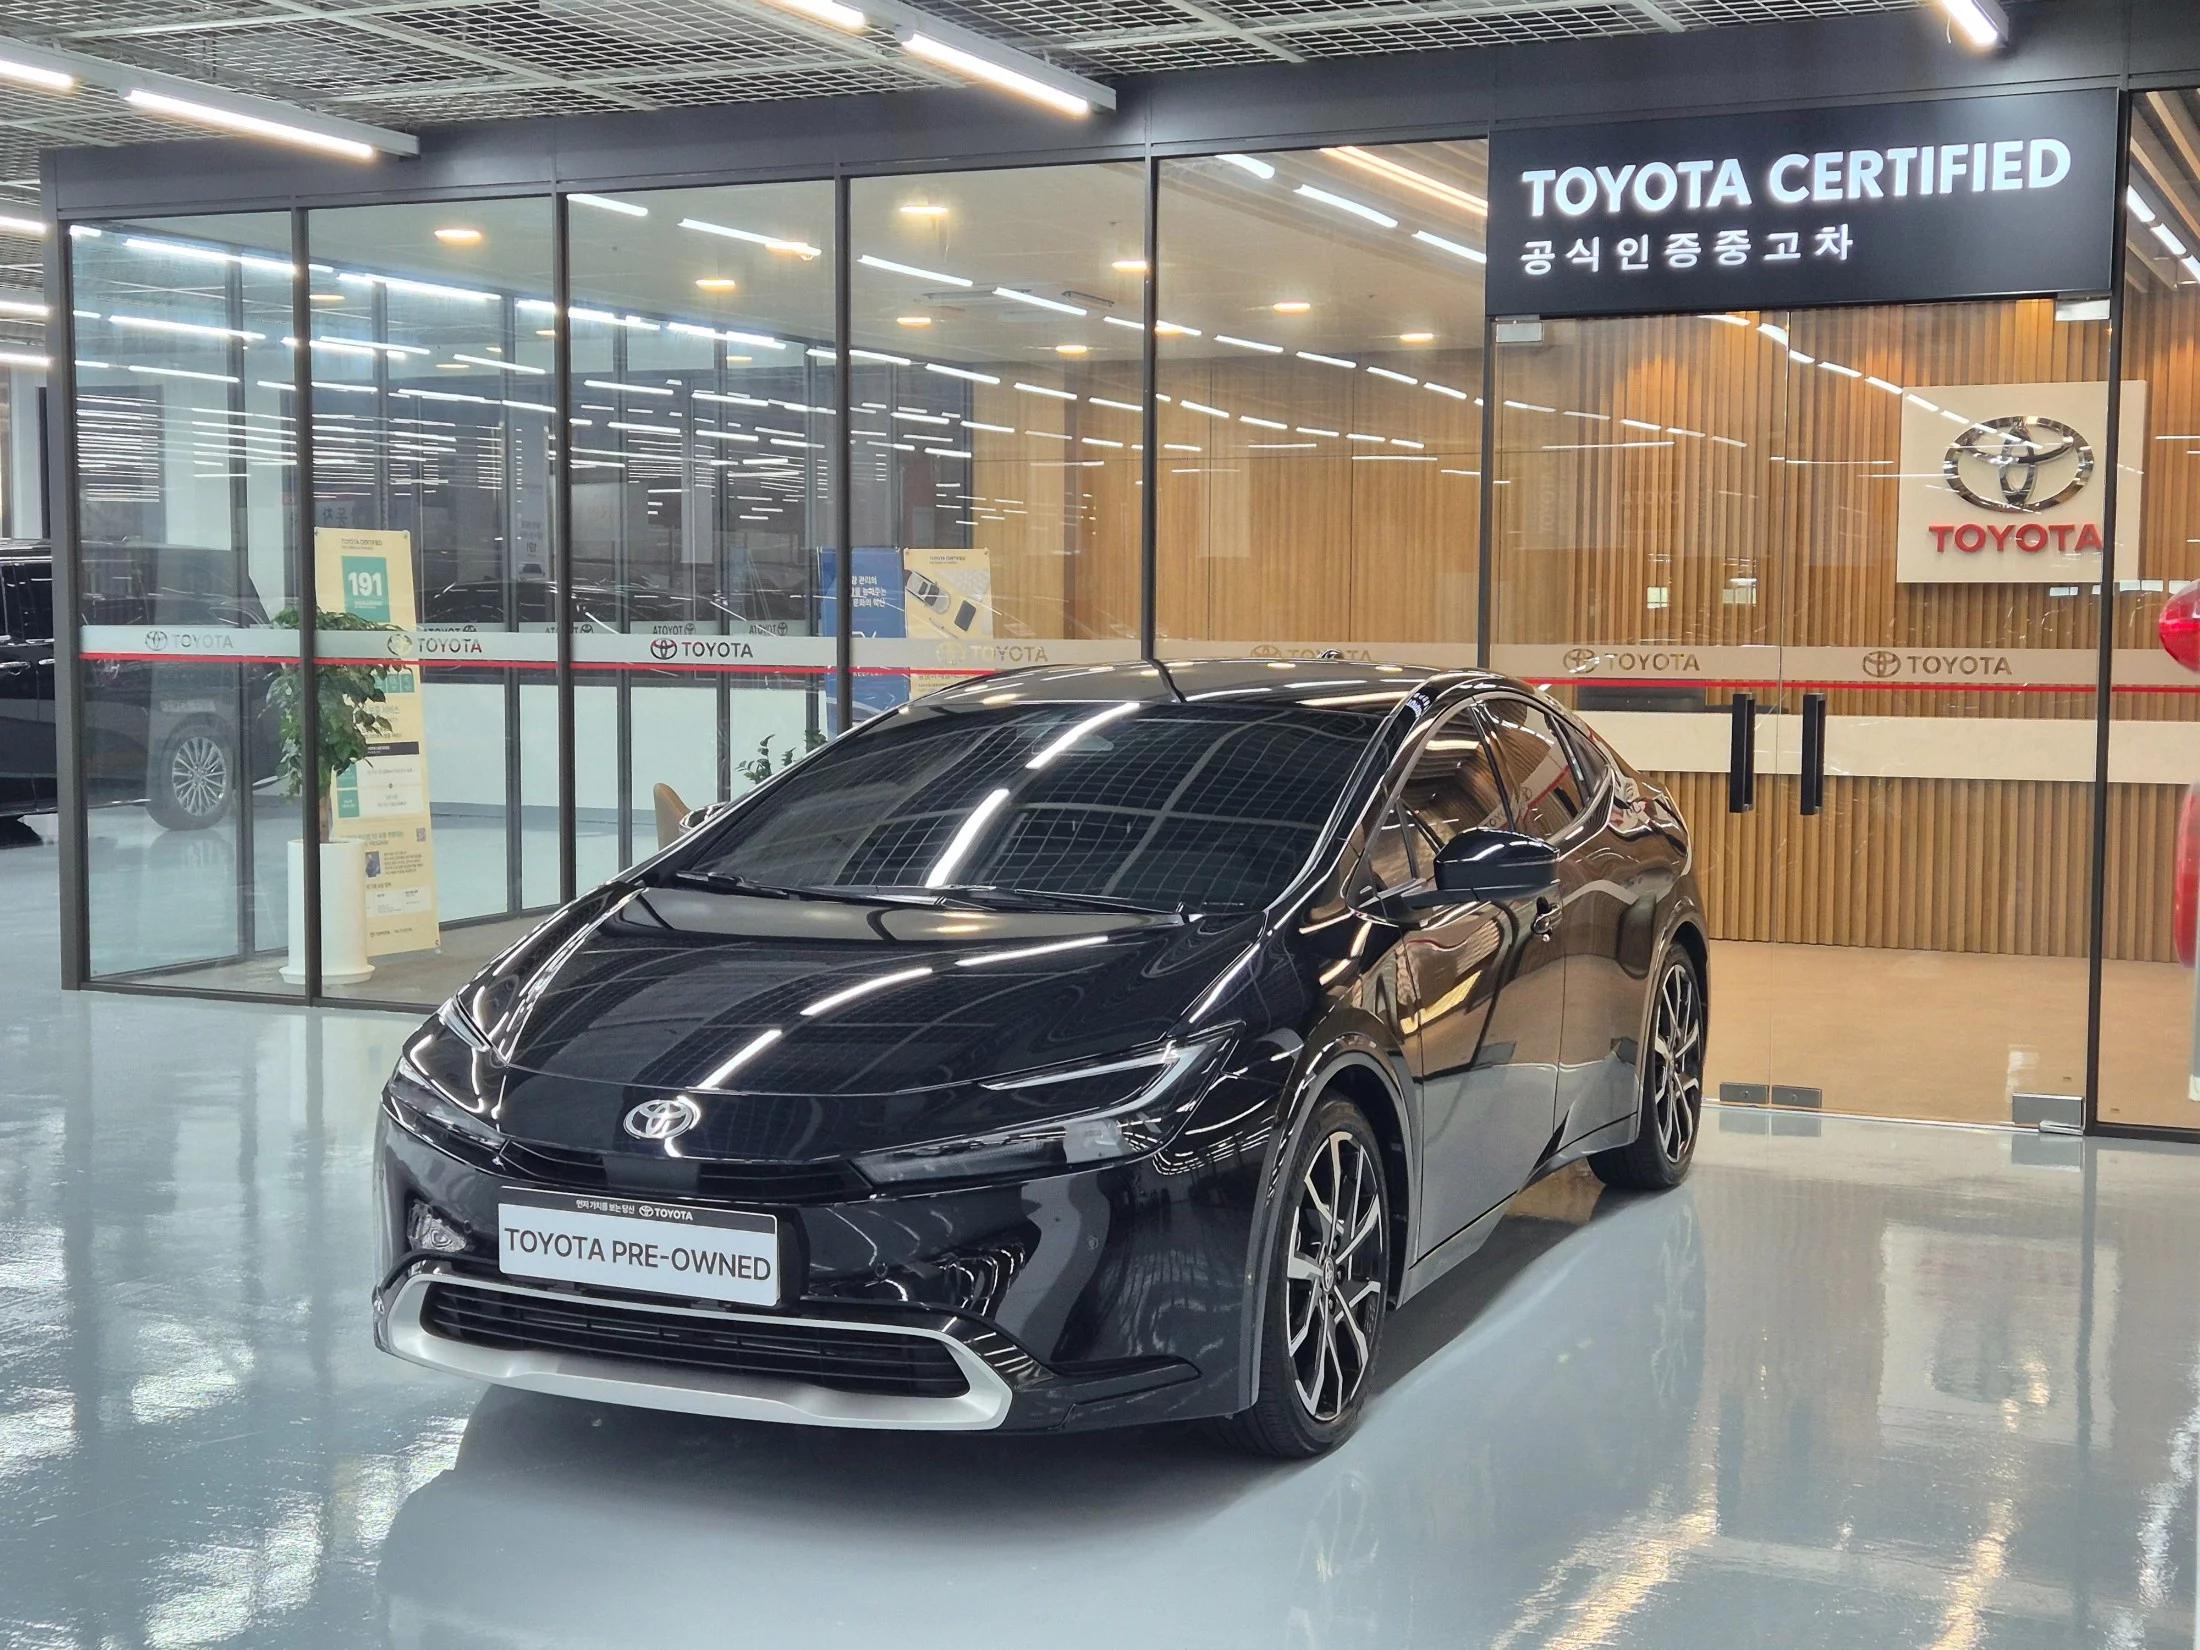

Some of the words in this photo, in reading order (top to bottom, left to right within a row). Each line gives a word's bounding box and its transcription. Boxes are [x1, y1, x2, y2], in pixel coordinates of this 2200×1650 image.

[1521, 158, 1753, 218] TOYOTA
[1768, 137, 2071, 203] CERTIFIED
[1520, 223, 1854, 276] 공식인증중고차
[1928, 523, 2103, 553] TOYOTA
[348, 571, 382, 597] 191
[173, 633, 234, 649] TOYOTA
[417, 637, 482, 653] TOYOTA
[681, 641, 754, 658] TOYOTA
[968, 645, 1049, 662] TOYOTA
[1604, 652, 1701, 671] TOYOTA
[1906, 655, 2013, 675] TOYOTA
[654, 1207, 693, 1221] TOYOTA
[504, 1227, 605, 1262] TOYOTA
[612, 1240, 771, 1281] PRE-OWNED
